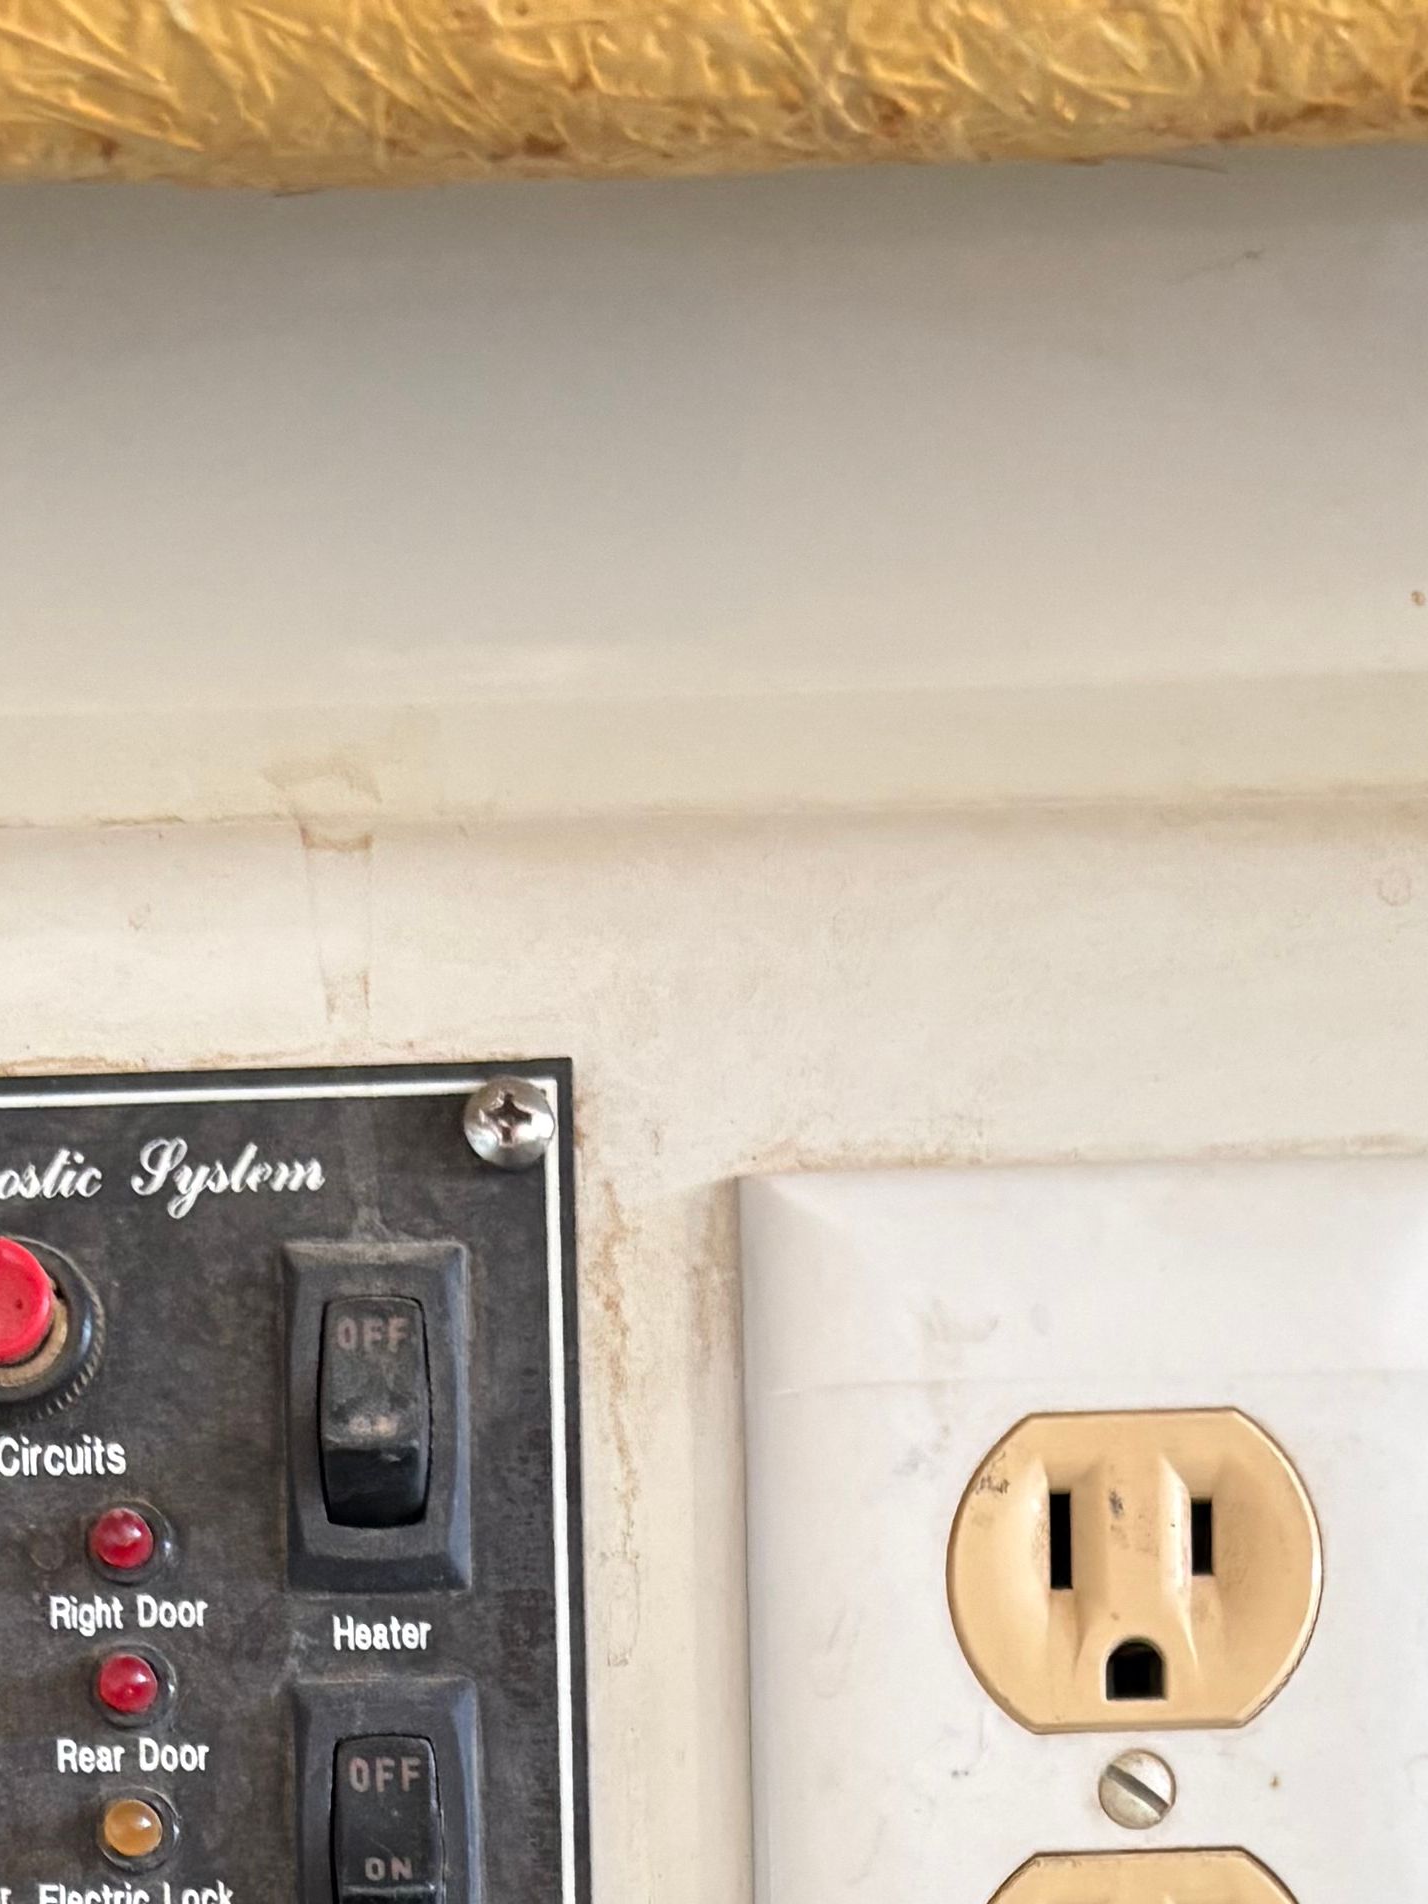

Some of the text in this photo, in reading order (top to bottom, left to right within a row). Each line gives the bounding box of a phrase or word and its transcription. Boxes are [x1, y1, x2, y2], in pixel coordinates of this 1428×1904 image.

[130, 1137, 326, 1219] System
[336, 1316, 409, 1351] OFF
[49, 1593, 209, 1637] Right Door
[332, 1614, 432, 1651] Heater
[56, 1736, 210, 1774] Rear Door
[348, 1756, 422, 1793] OFF
[364, 1856, 413, 1881] ON
